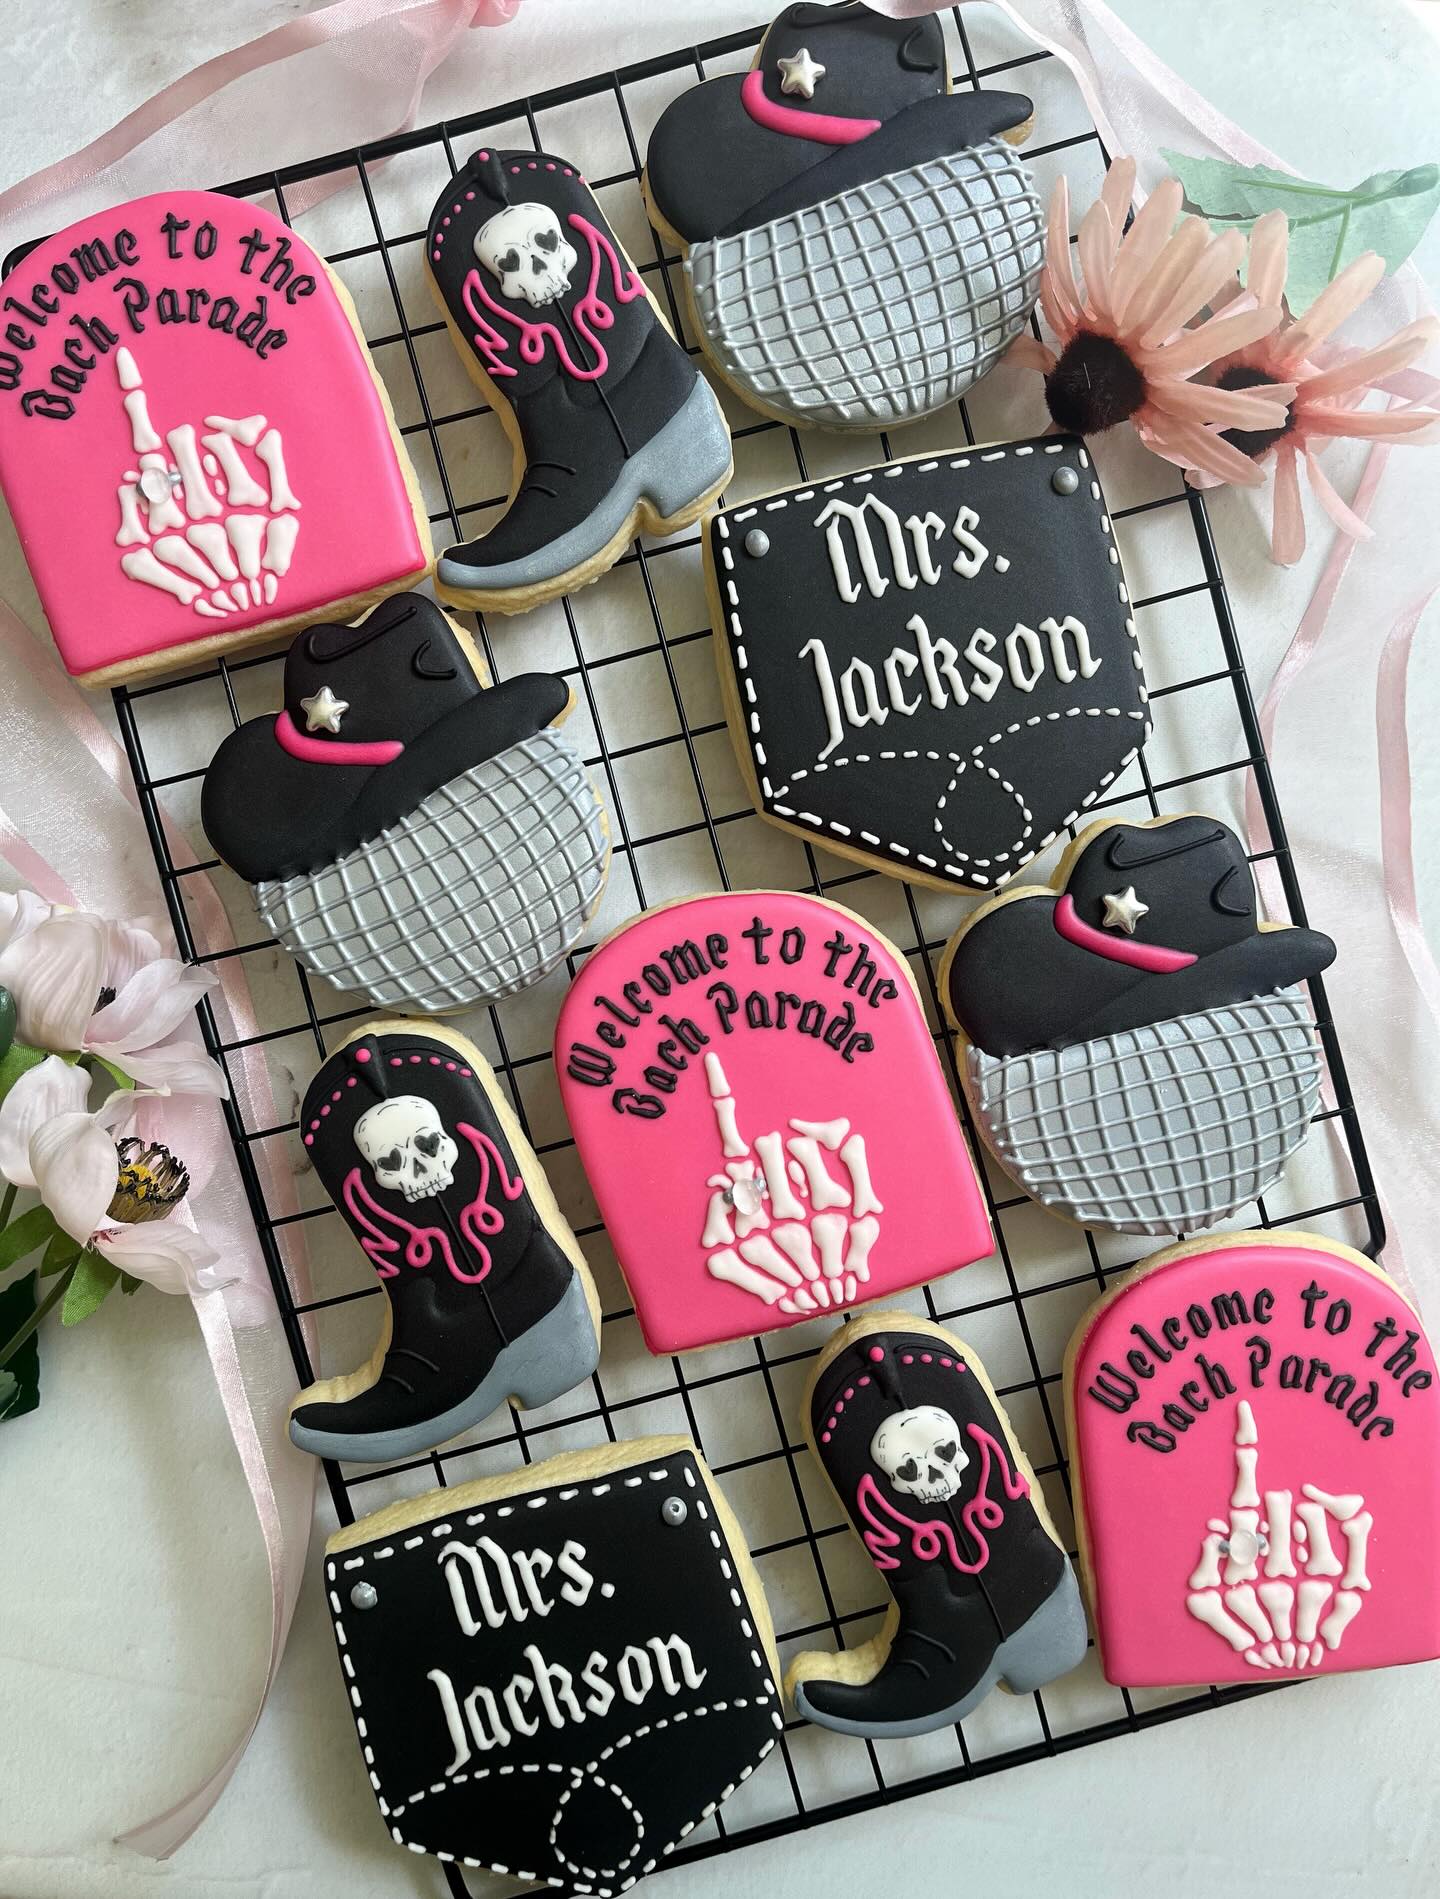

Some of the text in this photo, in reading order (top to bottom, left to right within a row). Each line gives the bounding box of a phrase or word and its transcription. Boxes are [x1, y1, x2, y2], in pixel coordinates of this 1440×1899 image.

[161, 212, 218, 259] to
[239, 228, 317, 304] the
[21, 277, 288, 420] Bach Parade
[813, 492, 1011, 603] Mrs.
[798, 613, 1103, 761] Jackson
[567, 916, 899, 1087] Welcome to the
[612, 981, 875, 1119] Bach Parade
[1088, 1280, 1432, 1413] Welcome to the
[1126, 1335, 1394, 1453] Bach Parade
[437, 1535, 616, 1637] Mrs.
[426, 1633, 708, 1776] Jackson
